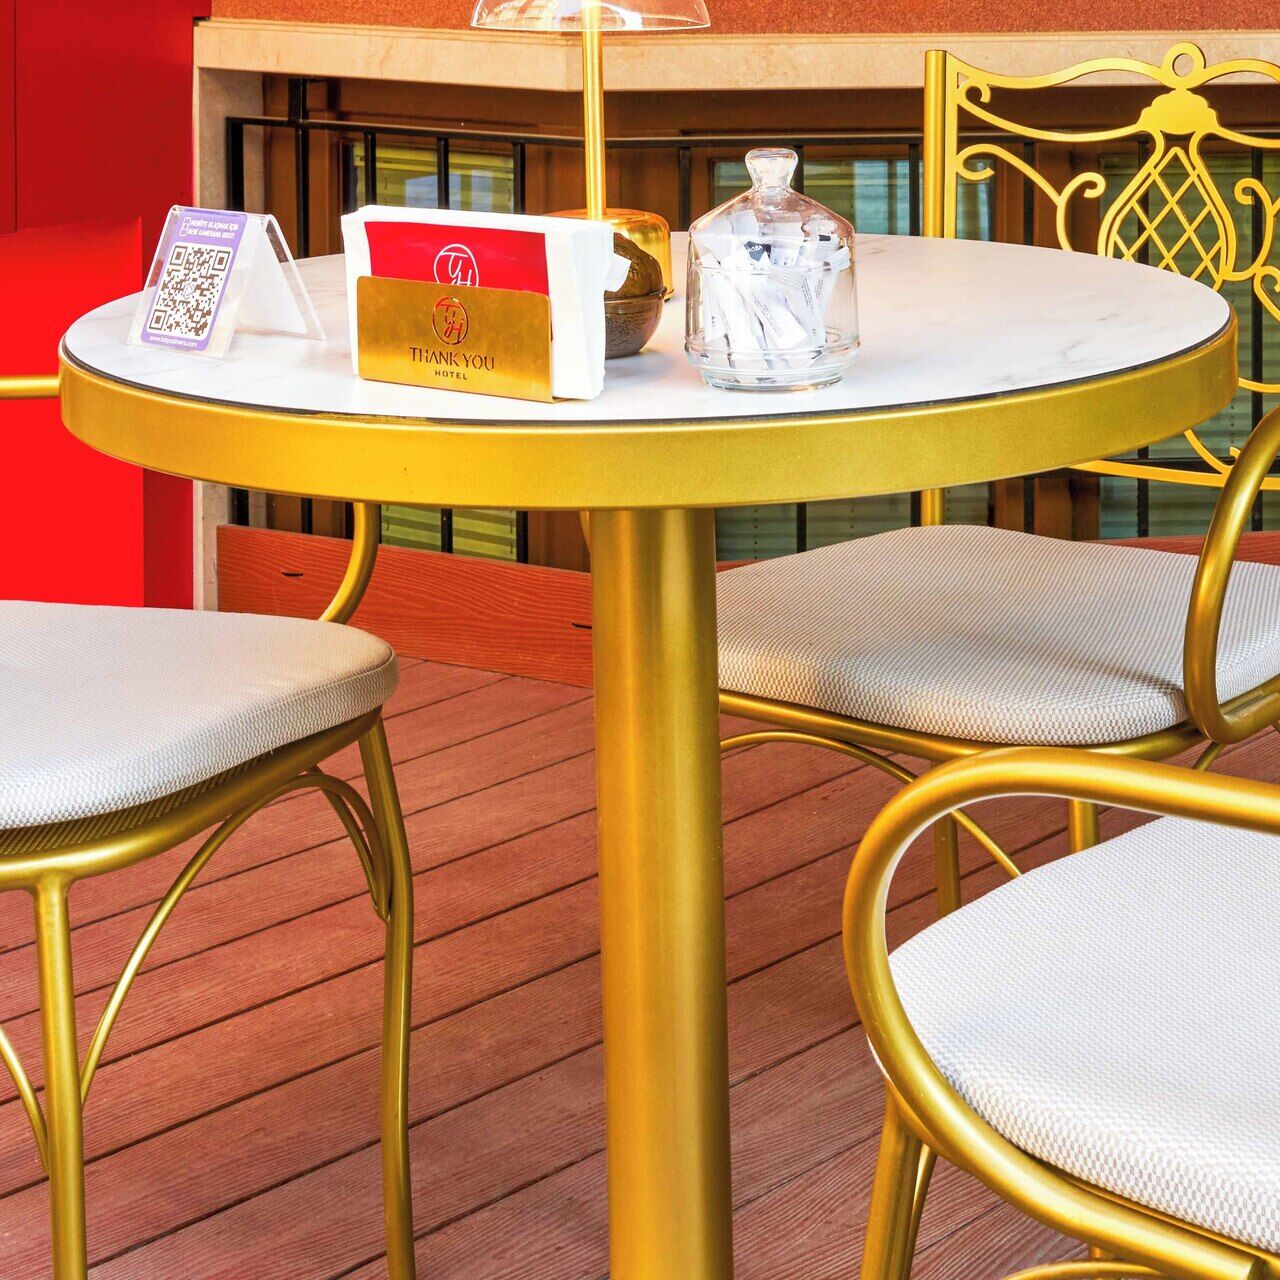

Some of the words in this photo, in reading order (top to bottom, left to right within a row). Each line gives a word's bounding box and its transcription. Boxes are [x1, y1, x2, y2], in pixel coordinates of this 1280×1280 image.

[409, 347, 459, 367] THANK
[462, 353, 495, 371] YOU
[434, 370, 468, 380] HOTEL
